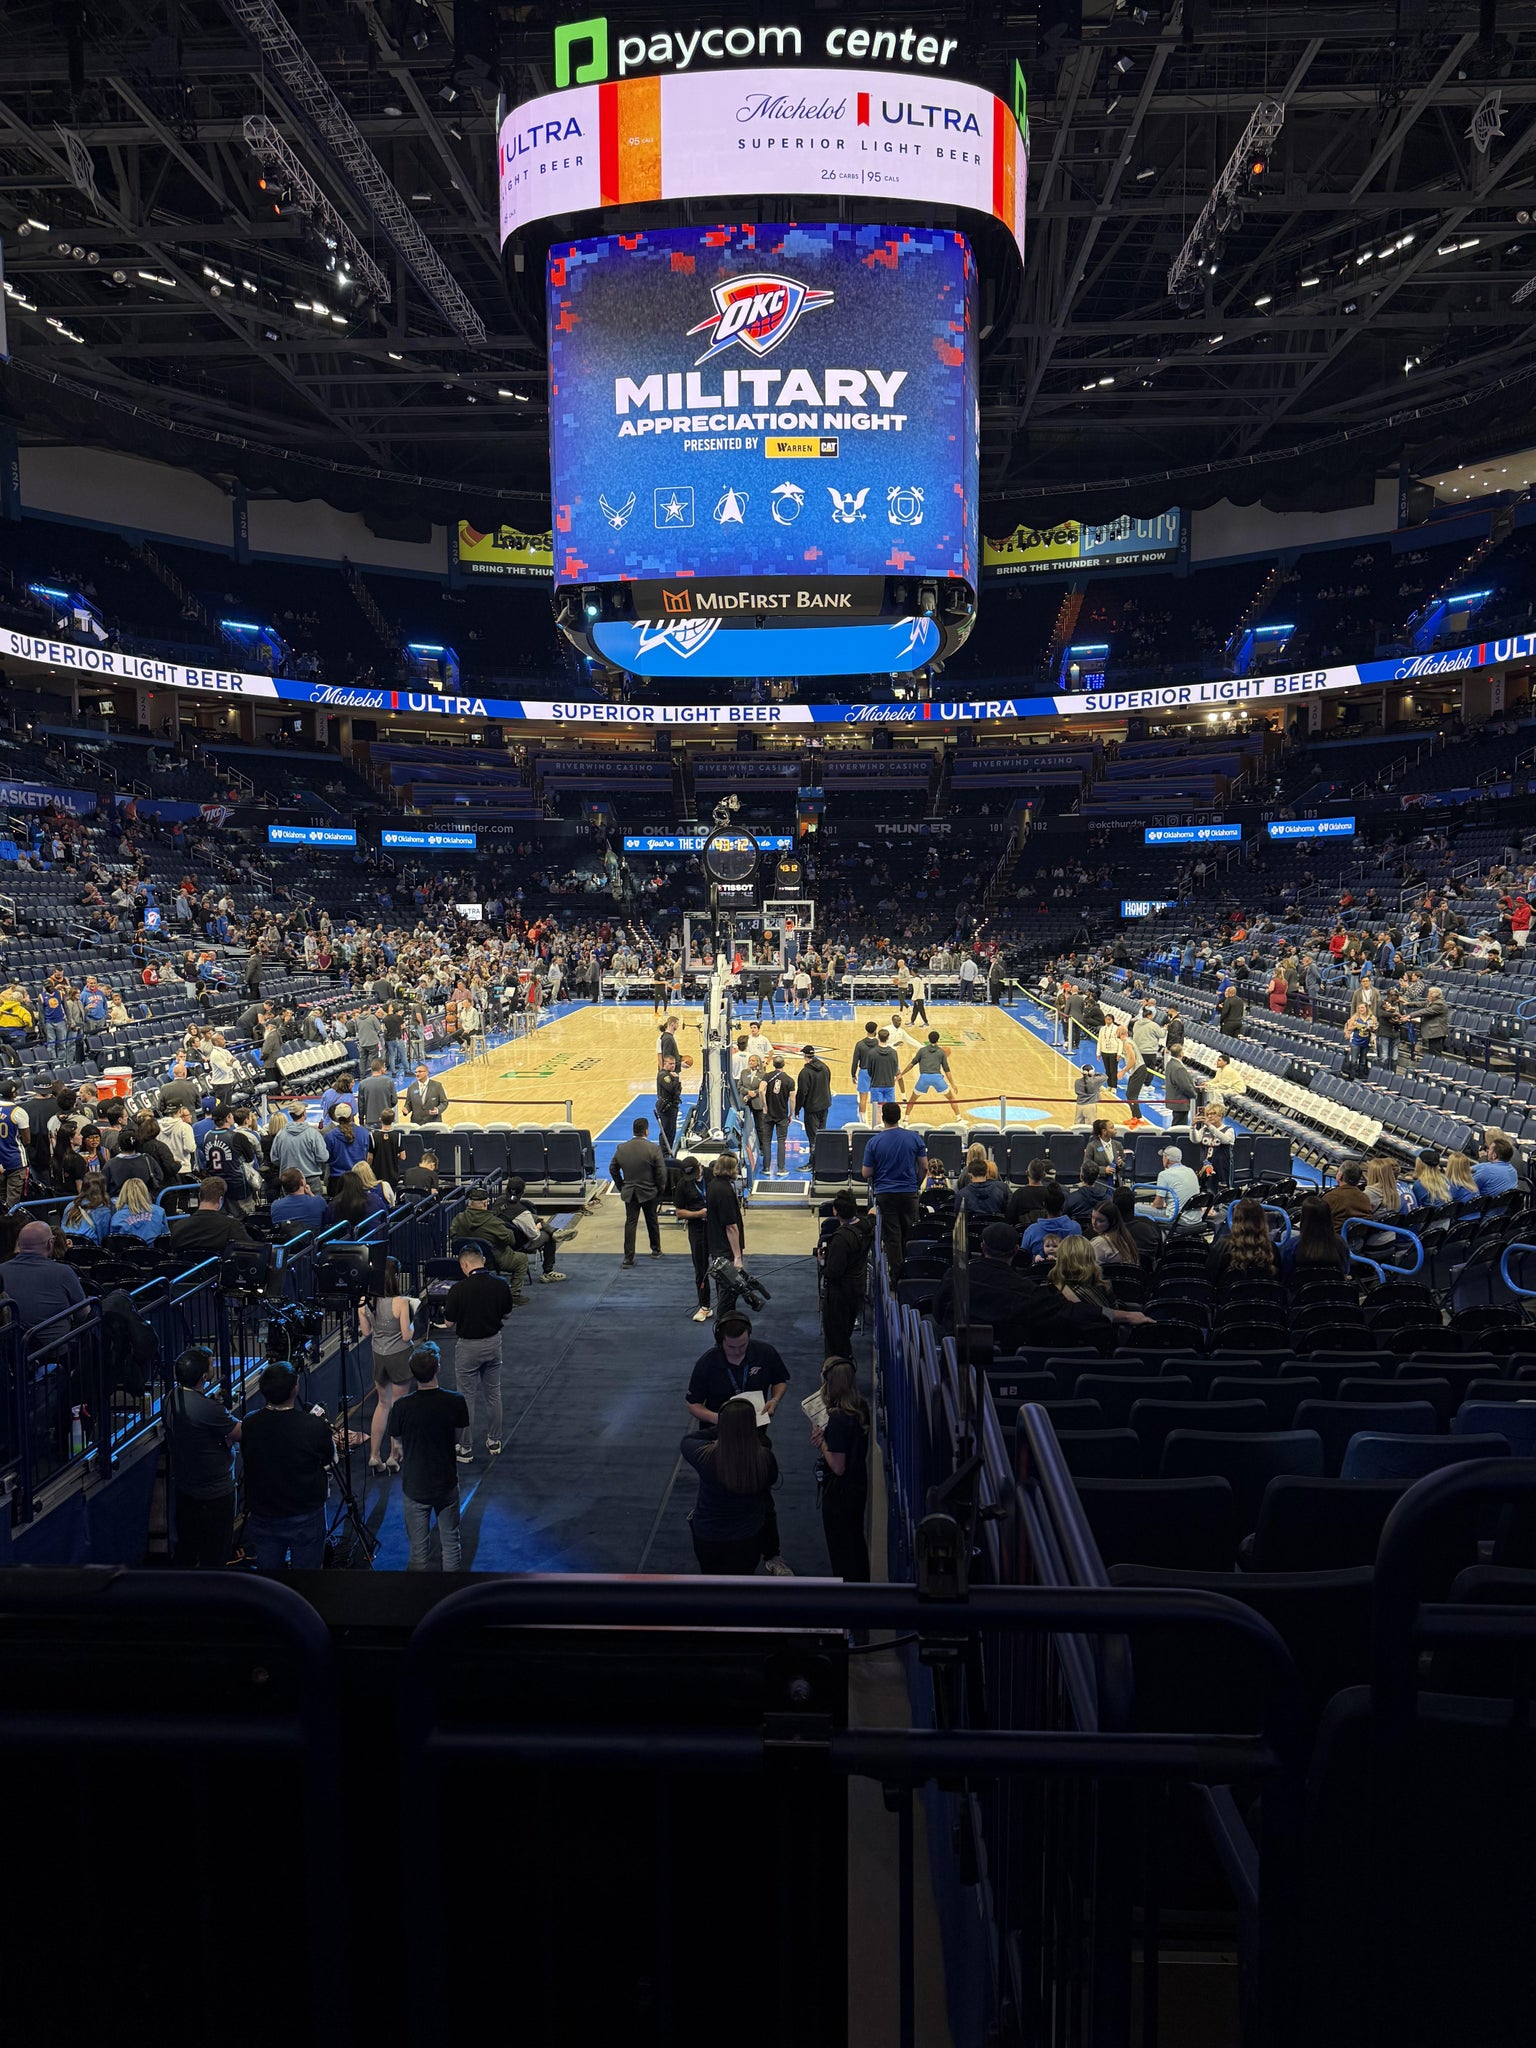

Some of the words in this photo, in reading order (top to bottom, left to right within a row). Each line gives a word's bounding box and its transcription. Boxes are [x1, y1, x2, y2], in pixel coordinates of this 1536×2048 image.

[618, 25, 802, 75] paycom
[826, 27, 957, 66] center
[736, 94, 847, 122] Michelob
[882, 101, 982, 137] ULTRA
[506, 117, 585, 163] ULTRA
[738, 138, 845, 150] SUPERIOR
[861, 140, 922, 155] LIGHT
[936, 147, 982, 166] BEER
[540, 155, 584, 175] BEER
[867, 171, 882, 182] 95
[718, 288, 786, 334] OKC
[615, 369, 908, 415] MILITARY
[618, 412, 818, 437] APPRECIATION
[824, 412, 908, 431] NIGHT
[683, 438, 743, 452] PRESENTED
[745, 437, 759, 450] BY
[821, 442, 837, 452] CAT
[472, 564, 504, 573] BRING
[506, 566, 527, 575] THE
[996, 565, 1027, 575] BRING
[1029, 563, 1050, 572] THE
[1052, 558, 1100, 569] THUNDER
[1115, 555, 1138, 564] EXIT
[1142, 552, 1167, 561] NOW
[10, 634, 115, 672] SUPERIOR
[122, 657, 178, 683] LIGHT
[186, 669, 243, 692] BEER
[1394, 649, 1473, 680] Michelob
[309, 683, 383, 709] Michelob
[408, 692, 488, 716] ULTRA
[1085, 687, 1191, 711] SUPERIOR
[1200, 679, 1265, 701] LIGHT
[1274, 671, 1327, 694] BEER
[552, 704, 655, 721] SUPERIOR
[663, 707, 721, 722] LIGHT
[729, 707, 781, 721] BEER
[844, 704, 917, 722] Michelob
[940, 701, 1018, 720] ULTRA
[616, 764, 653, 772] CASINO
[759, 764, 796, 772] CASINO
[889, 762, 927, 770] CASINO
[972, 758, 1029, 768] RIVERWIND
[1034, 757, 1073, 766] CASINO
[324, 833, 353, 841] Oklahoma
[1163, 830, 1194, 839] Oklahoma
[1210, 829, 1238, 837] Oklahoma
[1285, 826, 1315, 834] Oklahoma
[443, 836, 473, 845] Oklahoma
[679, 839, 694, 849] THE
[211, 1150, 222, 1169] 2
